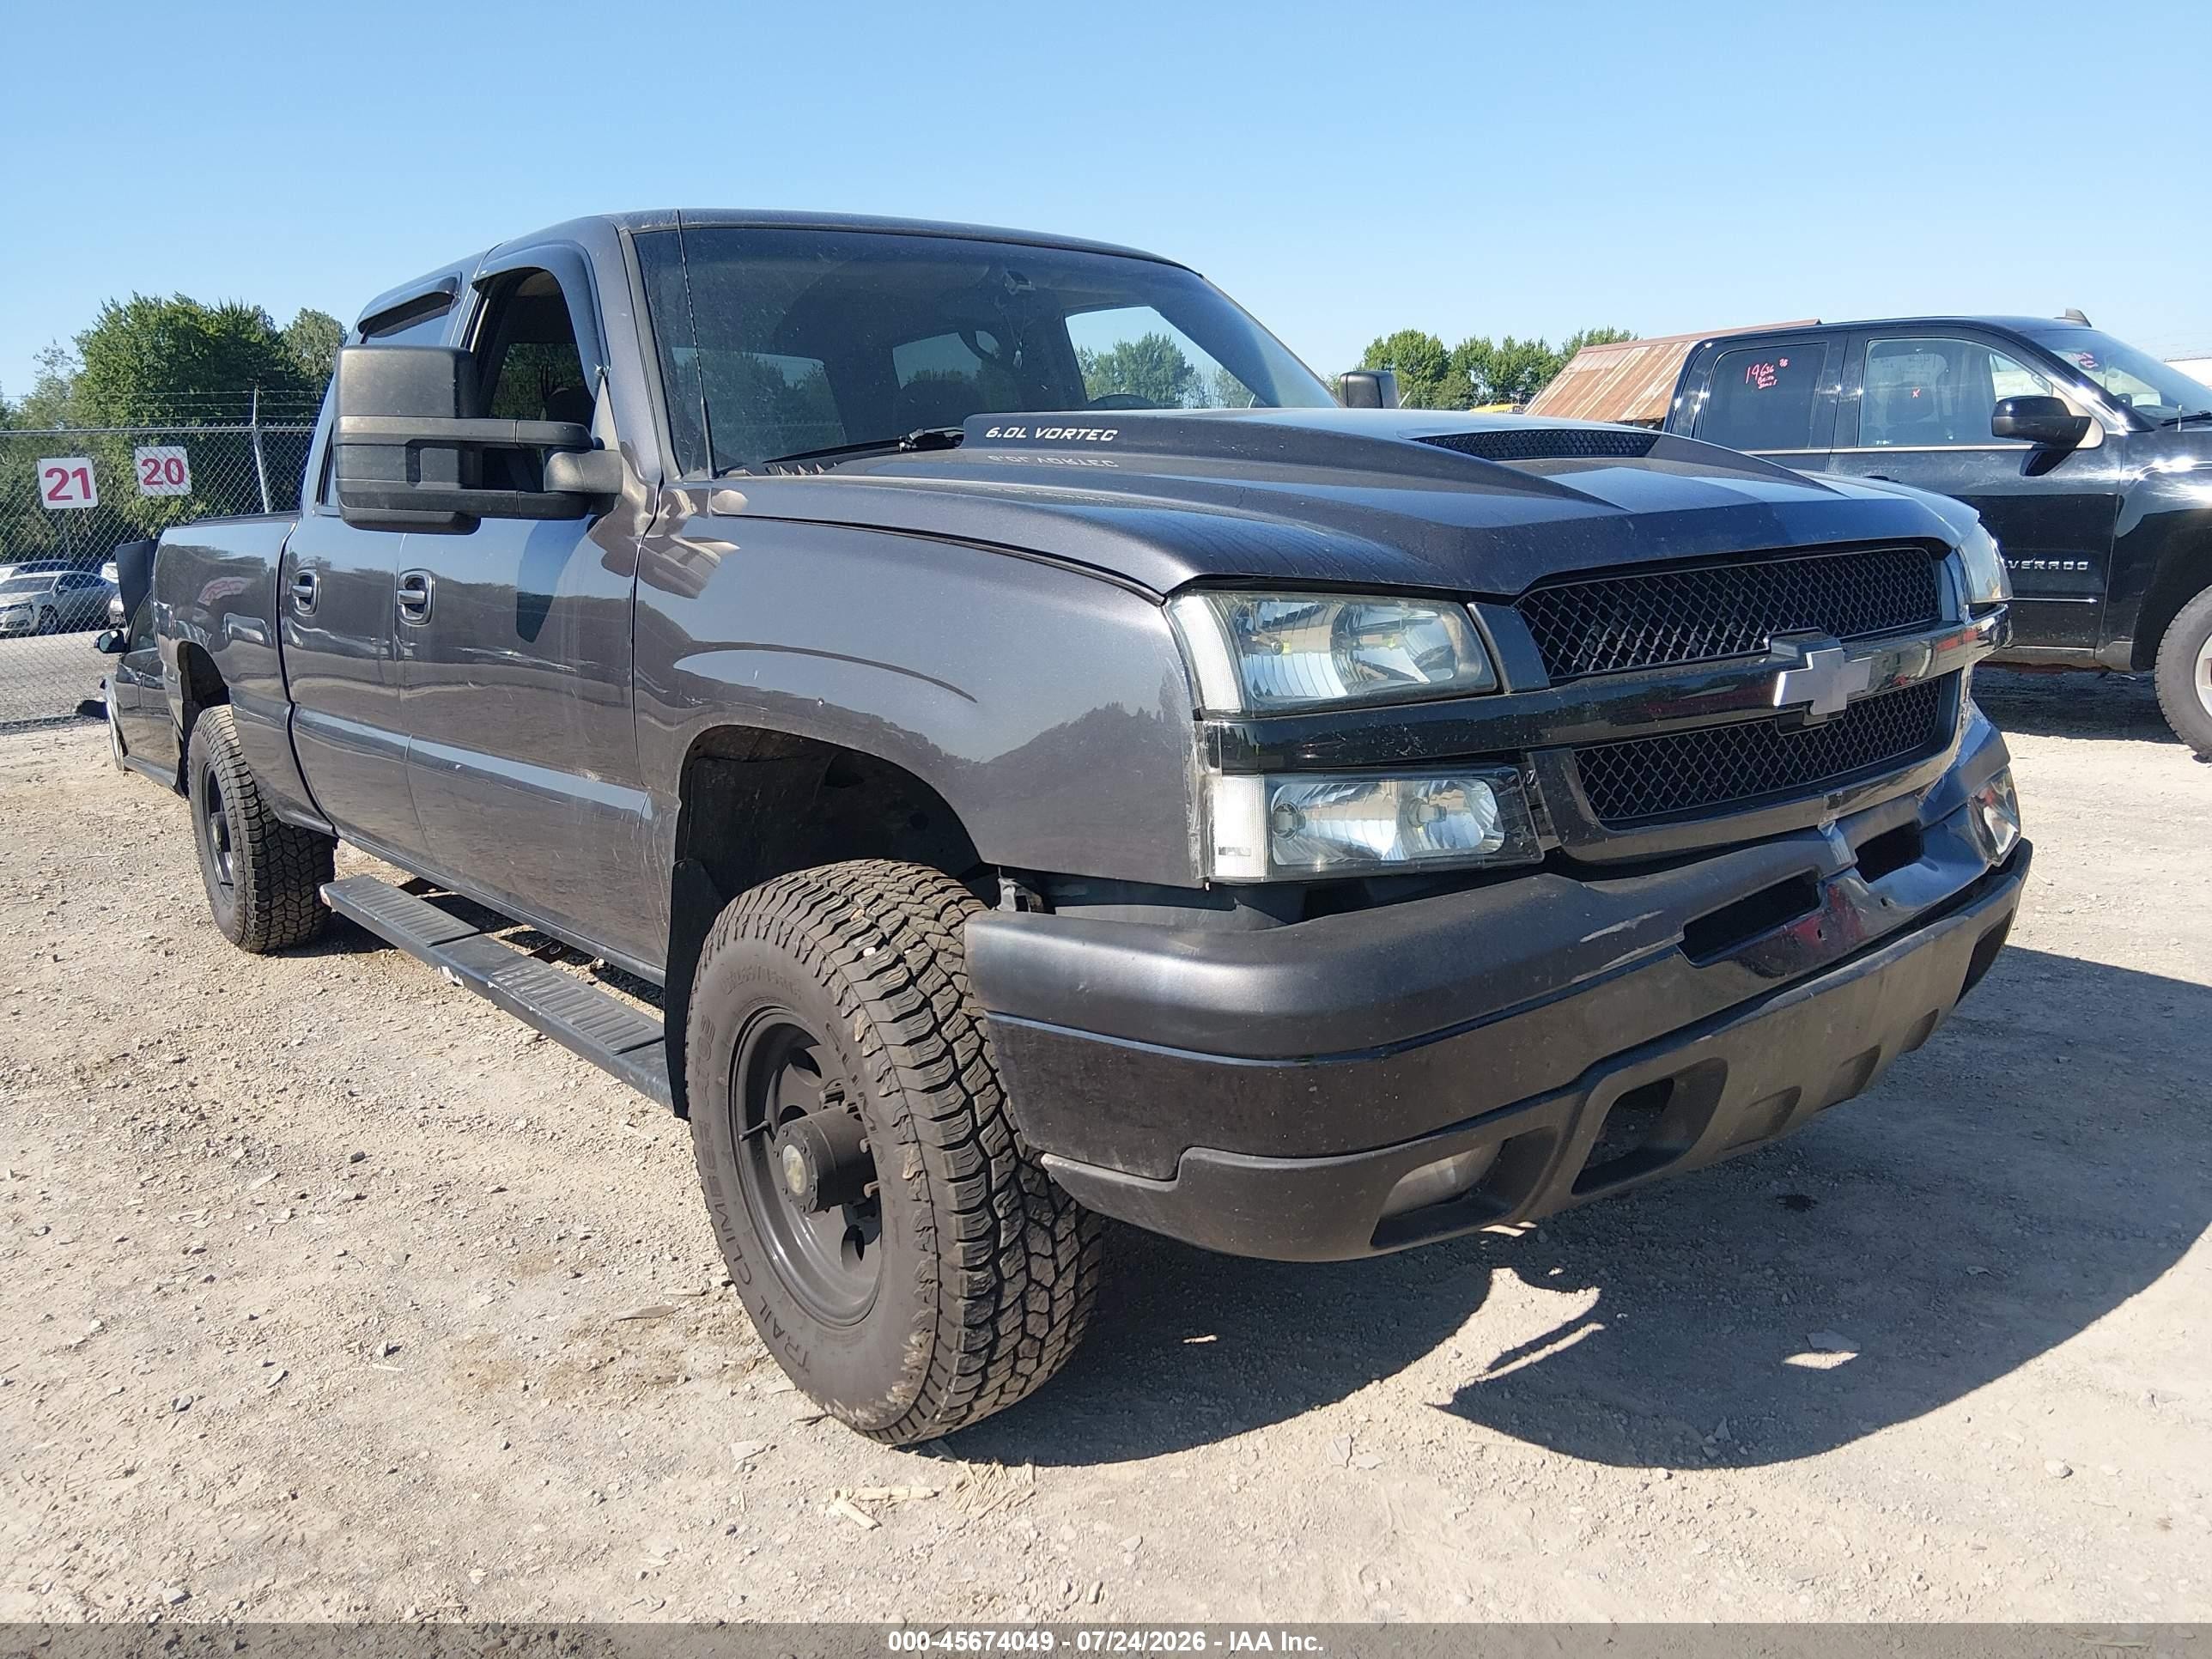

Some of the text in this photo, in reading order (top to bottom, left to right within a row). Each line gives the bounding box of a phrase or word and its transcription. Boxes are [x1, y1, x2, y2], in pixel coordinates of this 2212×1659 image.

[986, 427, 1118, 441] 6.0L VORTEC
[45, 467, 92, 501] 21
[141, 458, 185, 486] 20
[2005, 560, 2089, 570] VERADO
[697, 1119, 752, 1285] CLIMBER
